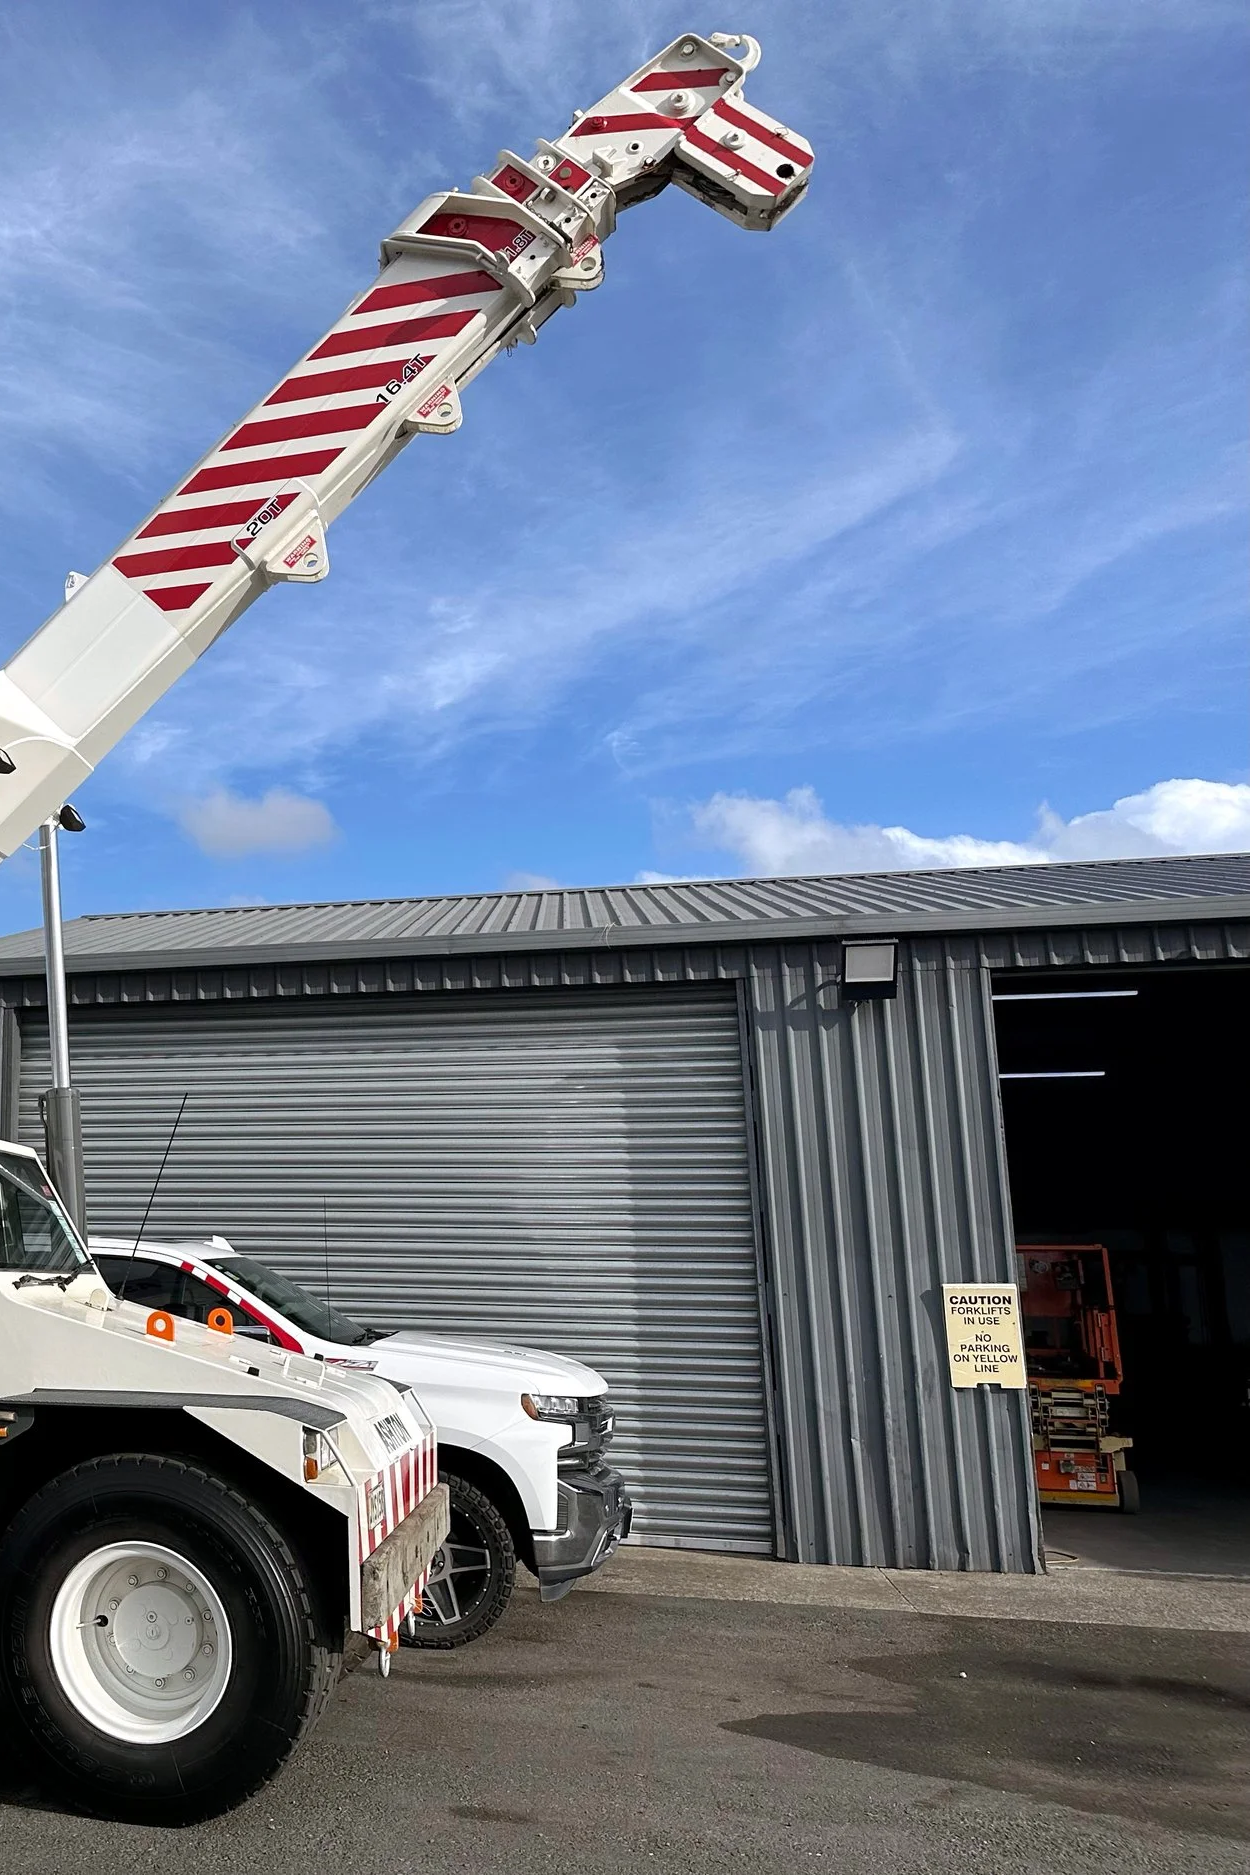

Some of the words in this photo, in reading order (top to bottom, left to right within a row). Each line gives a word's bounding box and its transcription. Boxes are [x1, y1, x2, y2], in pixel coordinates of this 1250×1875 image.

[375, 353, 429, 405] 16.4T
[246, 498, 282, 537] 20T
[949, 1295, 1012, 1305] CAUTION
[951, 1306, 1011, 1315] FORKLIFTS
[963, 1316, 975, 1325] IN
[978, 1316, 1000, 1325] USE
[975, 1333, 992, 1342] NO
[960, 1344, 1010, 1353] PARKING
[953, 1354, 970, 1362] ON
[973, 1354, 1018, 1363] YELLOW
[974, 1364, 1000, 1373] LINE
[373, 1412, 413, 1454] ASHTON
